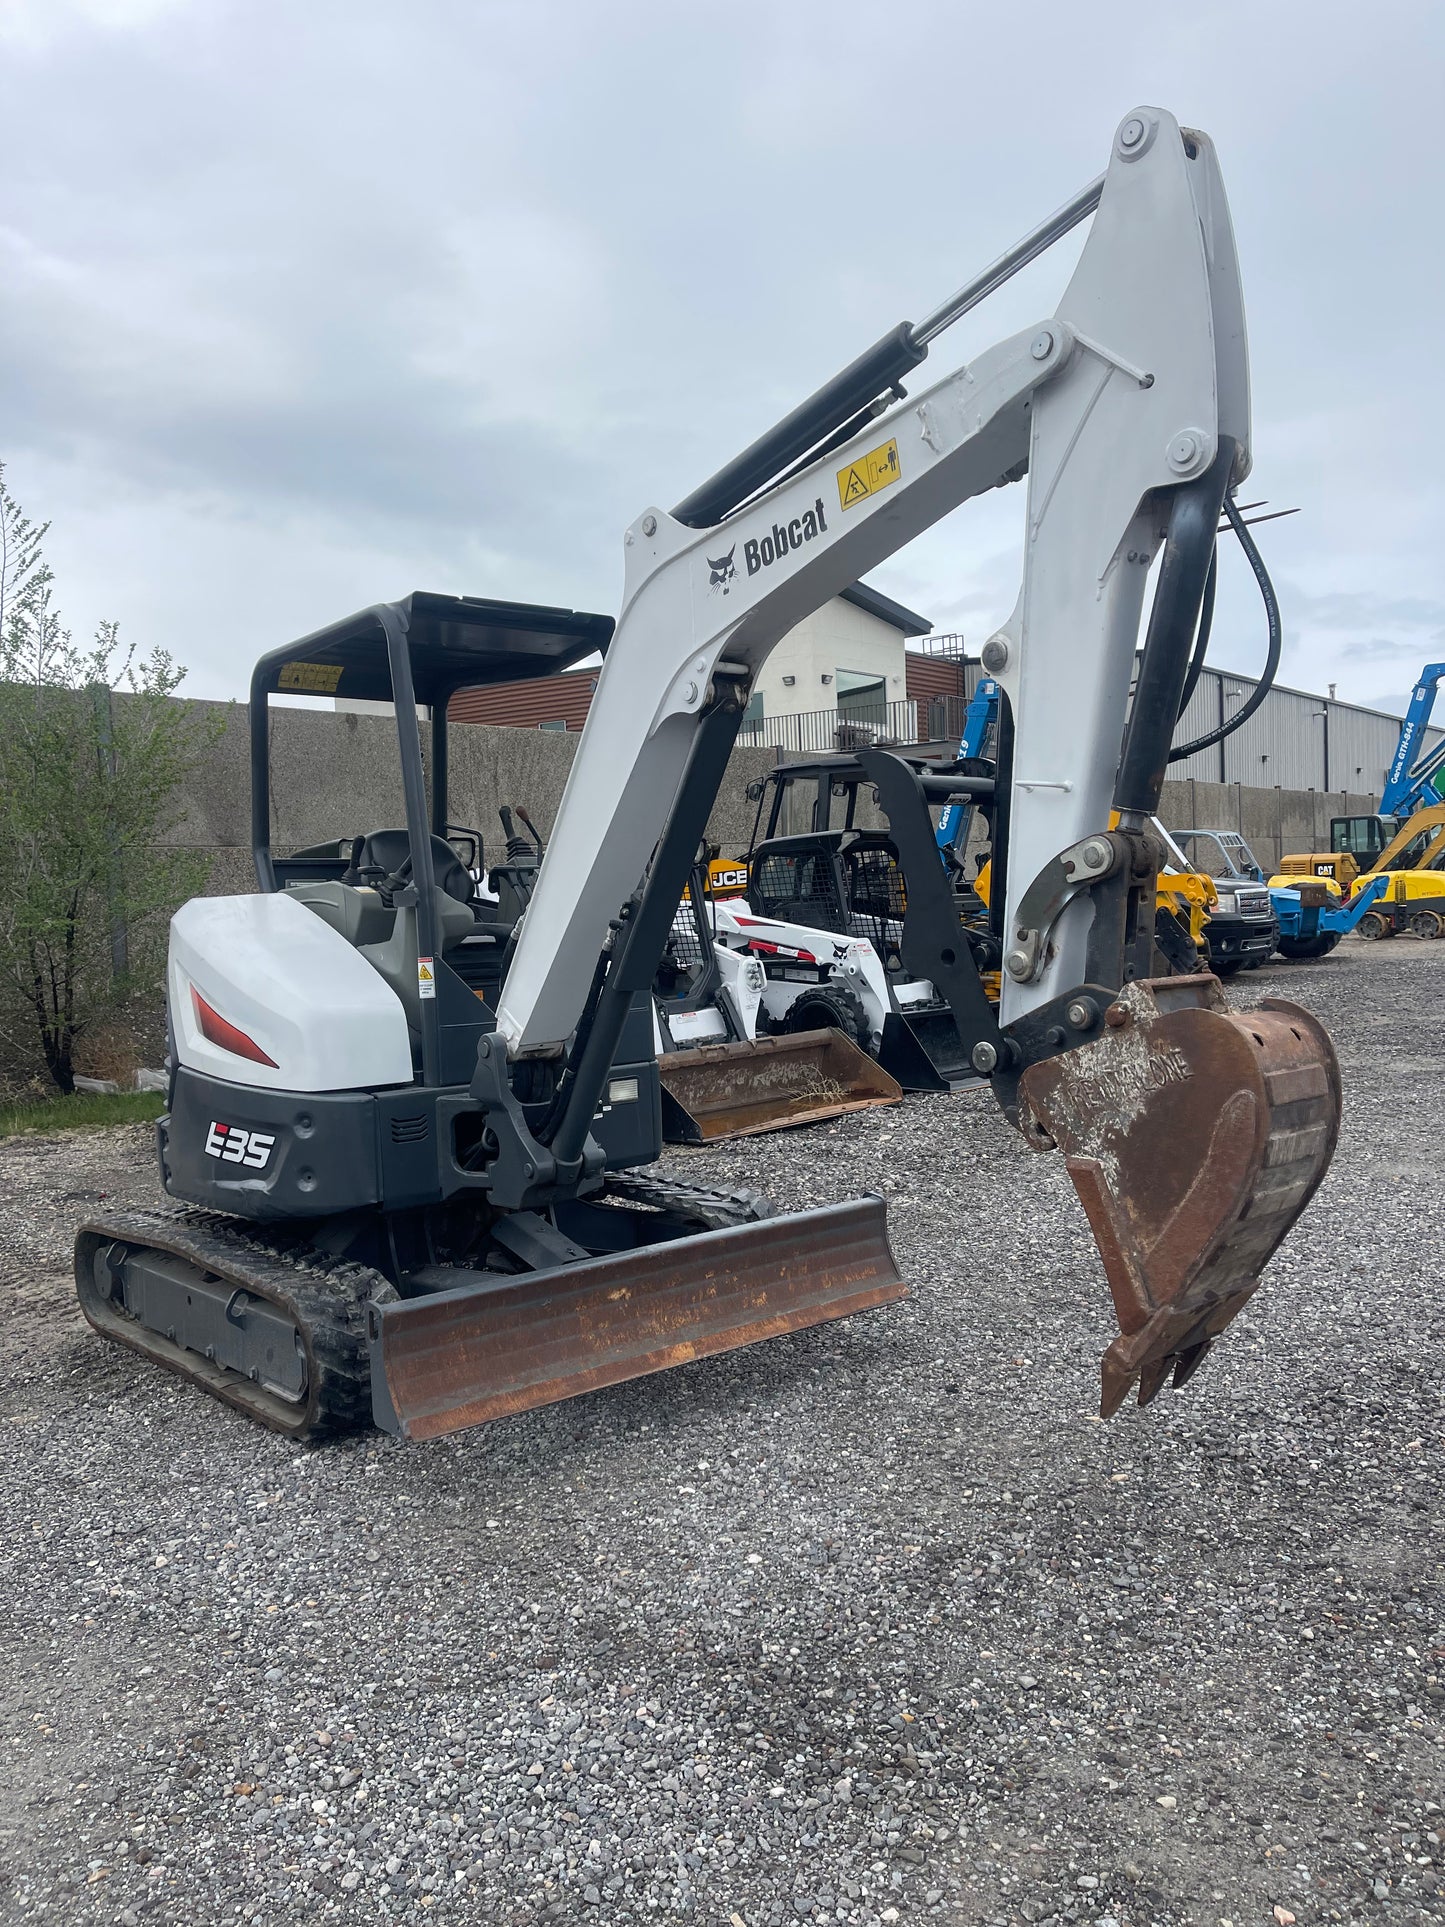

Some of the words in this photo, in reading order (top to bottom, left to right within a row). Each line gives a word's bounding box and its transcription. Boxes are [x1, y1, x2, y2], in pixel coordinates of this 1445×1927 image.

[743, 497, 828, 577] Bobcat
[1390, 761, 1403, 784] Genie
[1398, 721, 1415, 760] GTH-844
[1317, 865, 1334, 876] CAT
[204, 1120, 276, 1169] E35
